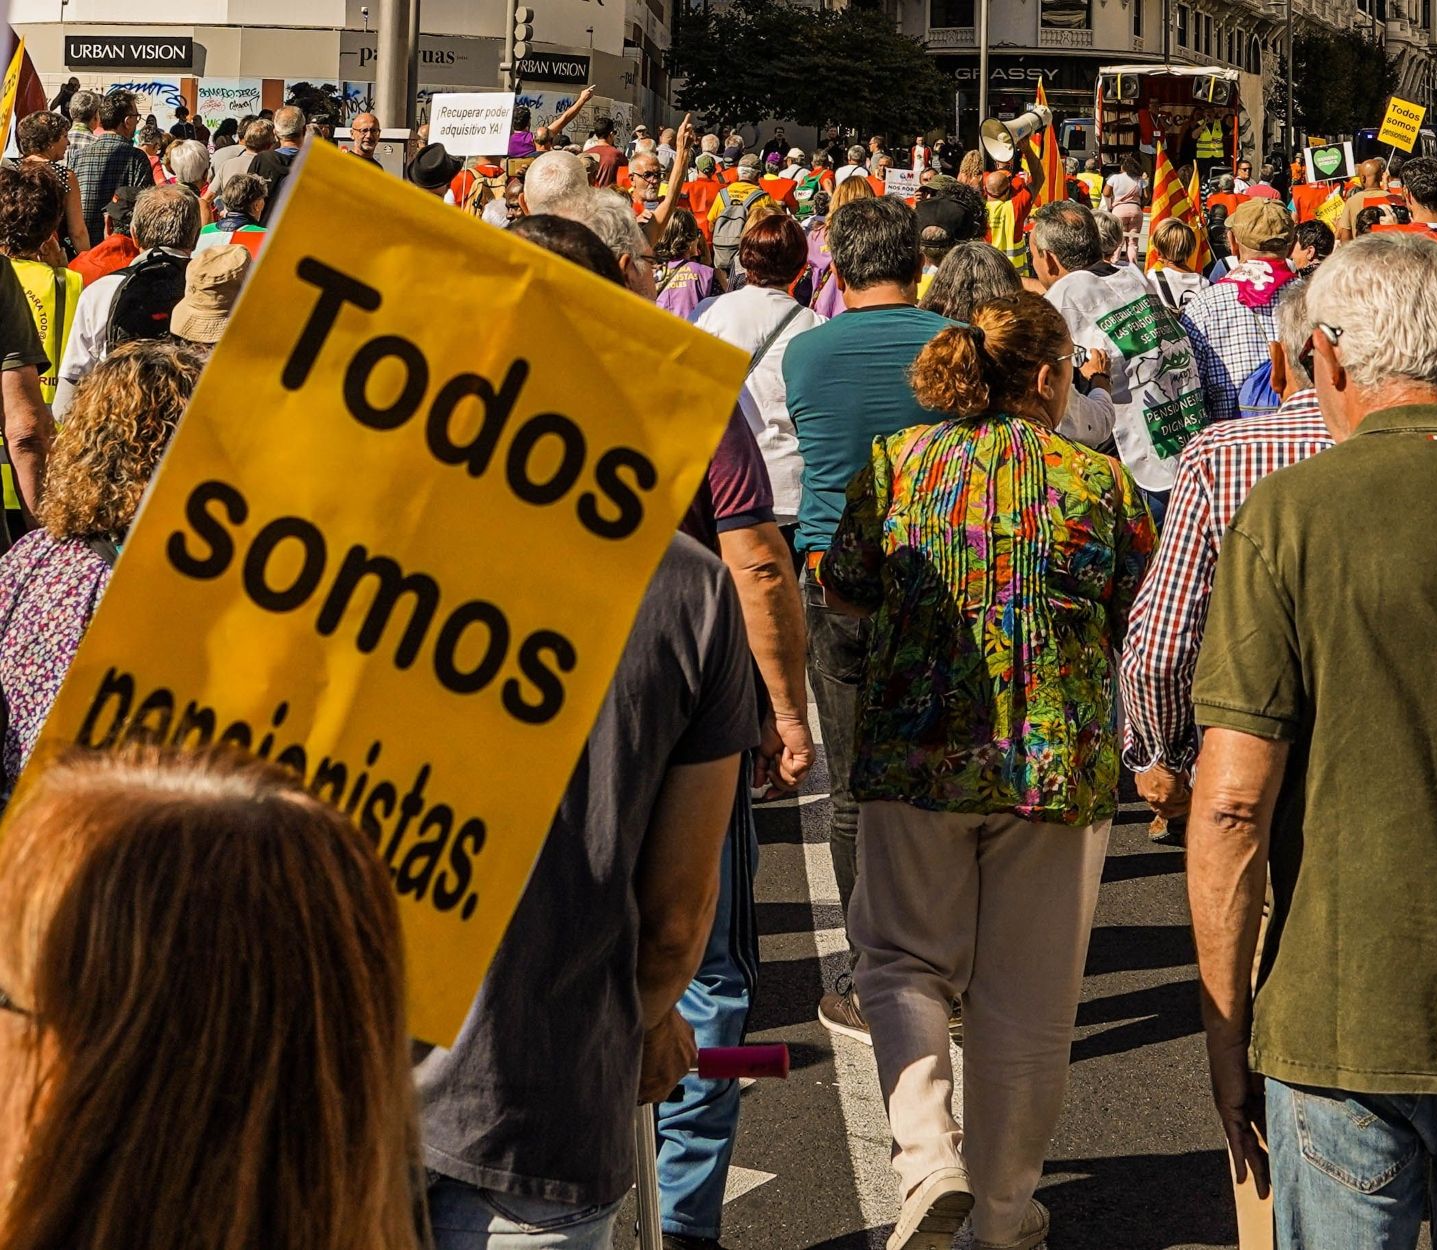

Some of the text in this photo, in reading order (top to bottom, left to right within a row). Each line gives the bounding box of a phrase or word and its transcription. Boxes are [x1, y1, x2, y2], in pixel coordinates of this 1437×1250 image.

[70, 44, 186, 59] URBAN VISION
[518, 59, 587, 77] RBAN VISION
[437, 106, 511, 121] ¡Recuperar poder
[1391, 103, 1421, 122] Todos
[440, 122, 503, 137] adquisitivo YA!
[1386, 117, 1417, 133] somos
[25, 289, 44, 312] PARA
[1114, 326, 1129, 339] LAS
[1140, 331, 1151, 344] SE
[280, 255, 659, 541] Todos
[166, 479, 577, 726] somos
